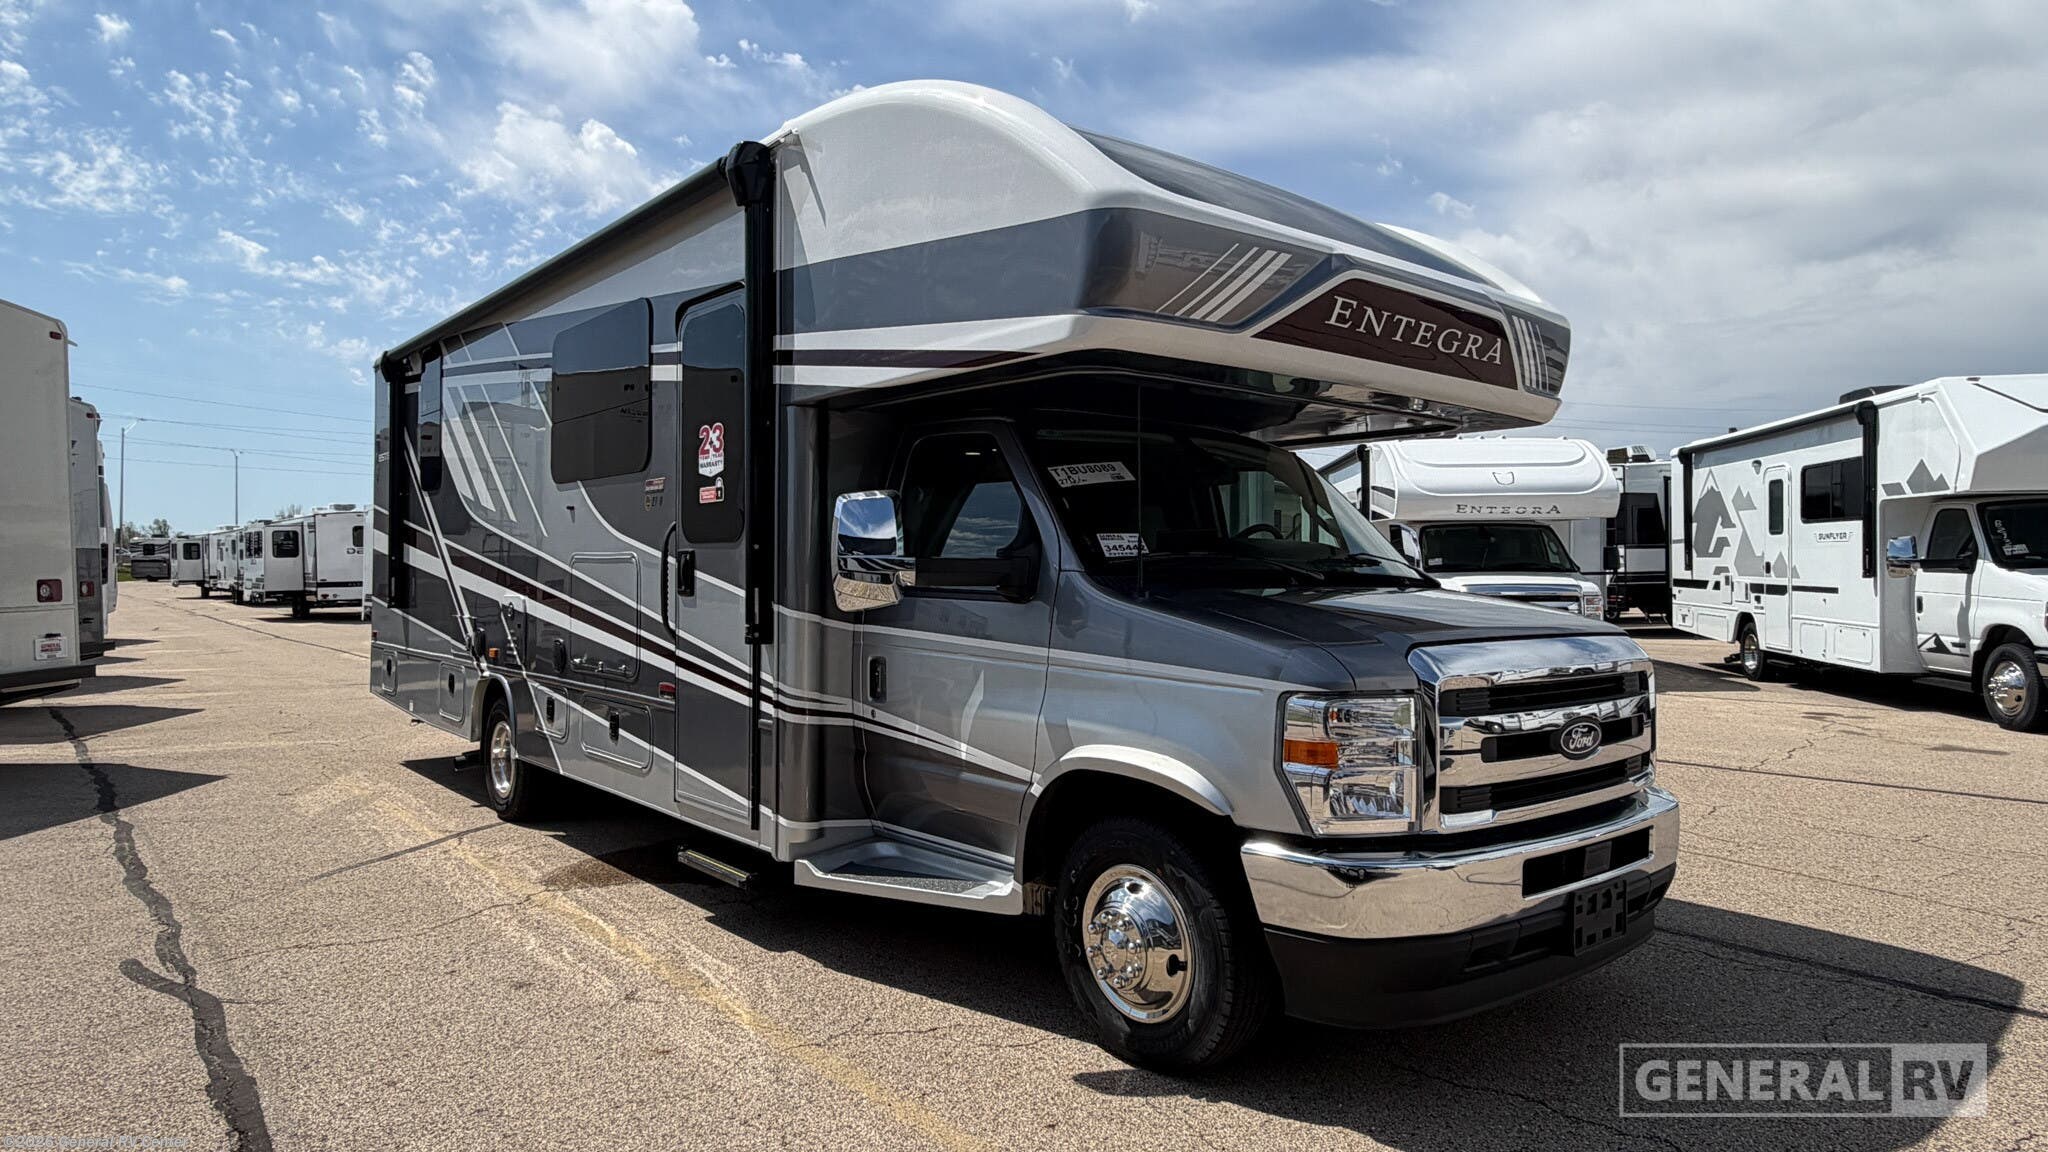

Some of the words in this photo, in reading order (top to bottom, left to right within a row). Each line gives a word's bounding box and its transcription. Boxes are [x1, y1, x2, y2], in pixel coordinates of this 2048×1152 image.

[1325, 296, 1503, 365] ENTEGRA
[1456, 504, 1562, 515] ENTEGRA
[1569, 727, 1594, 750] Ford
